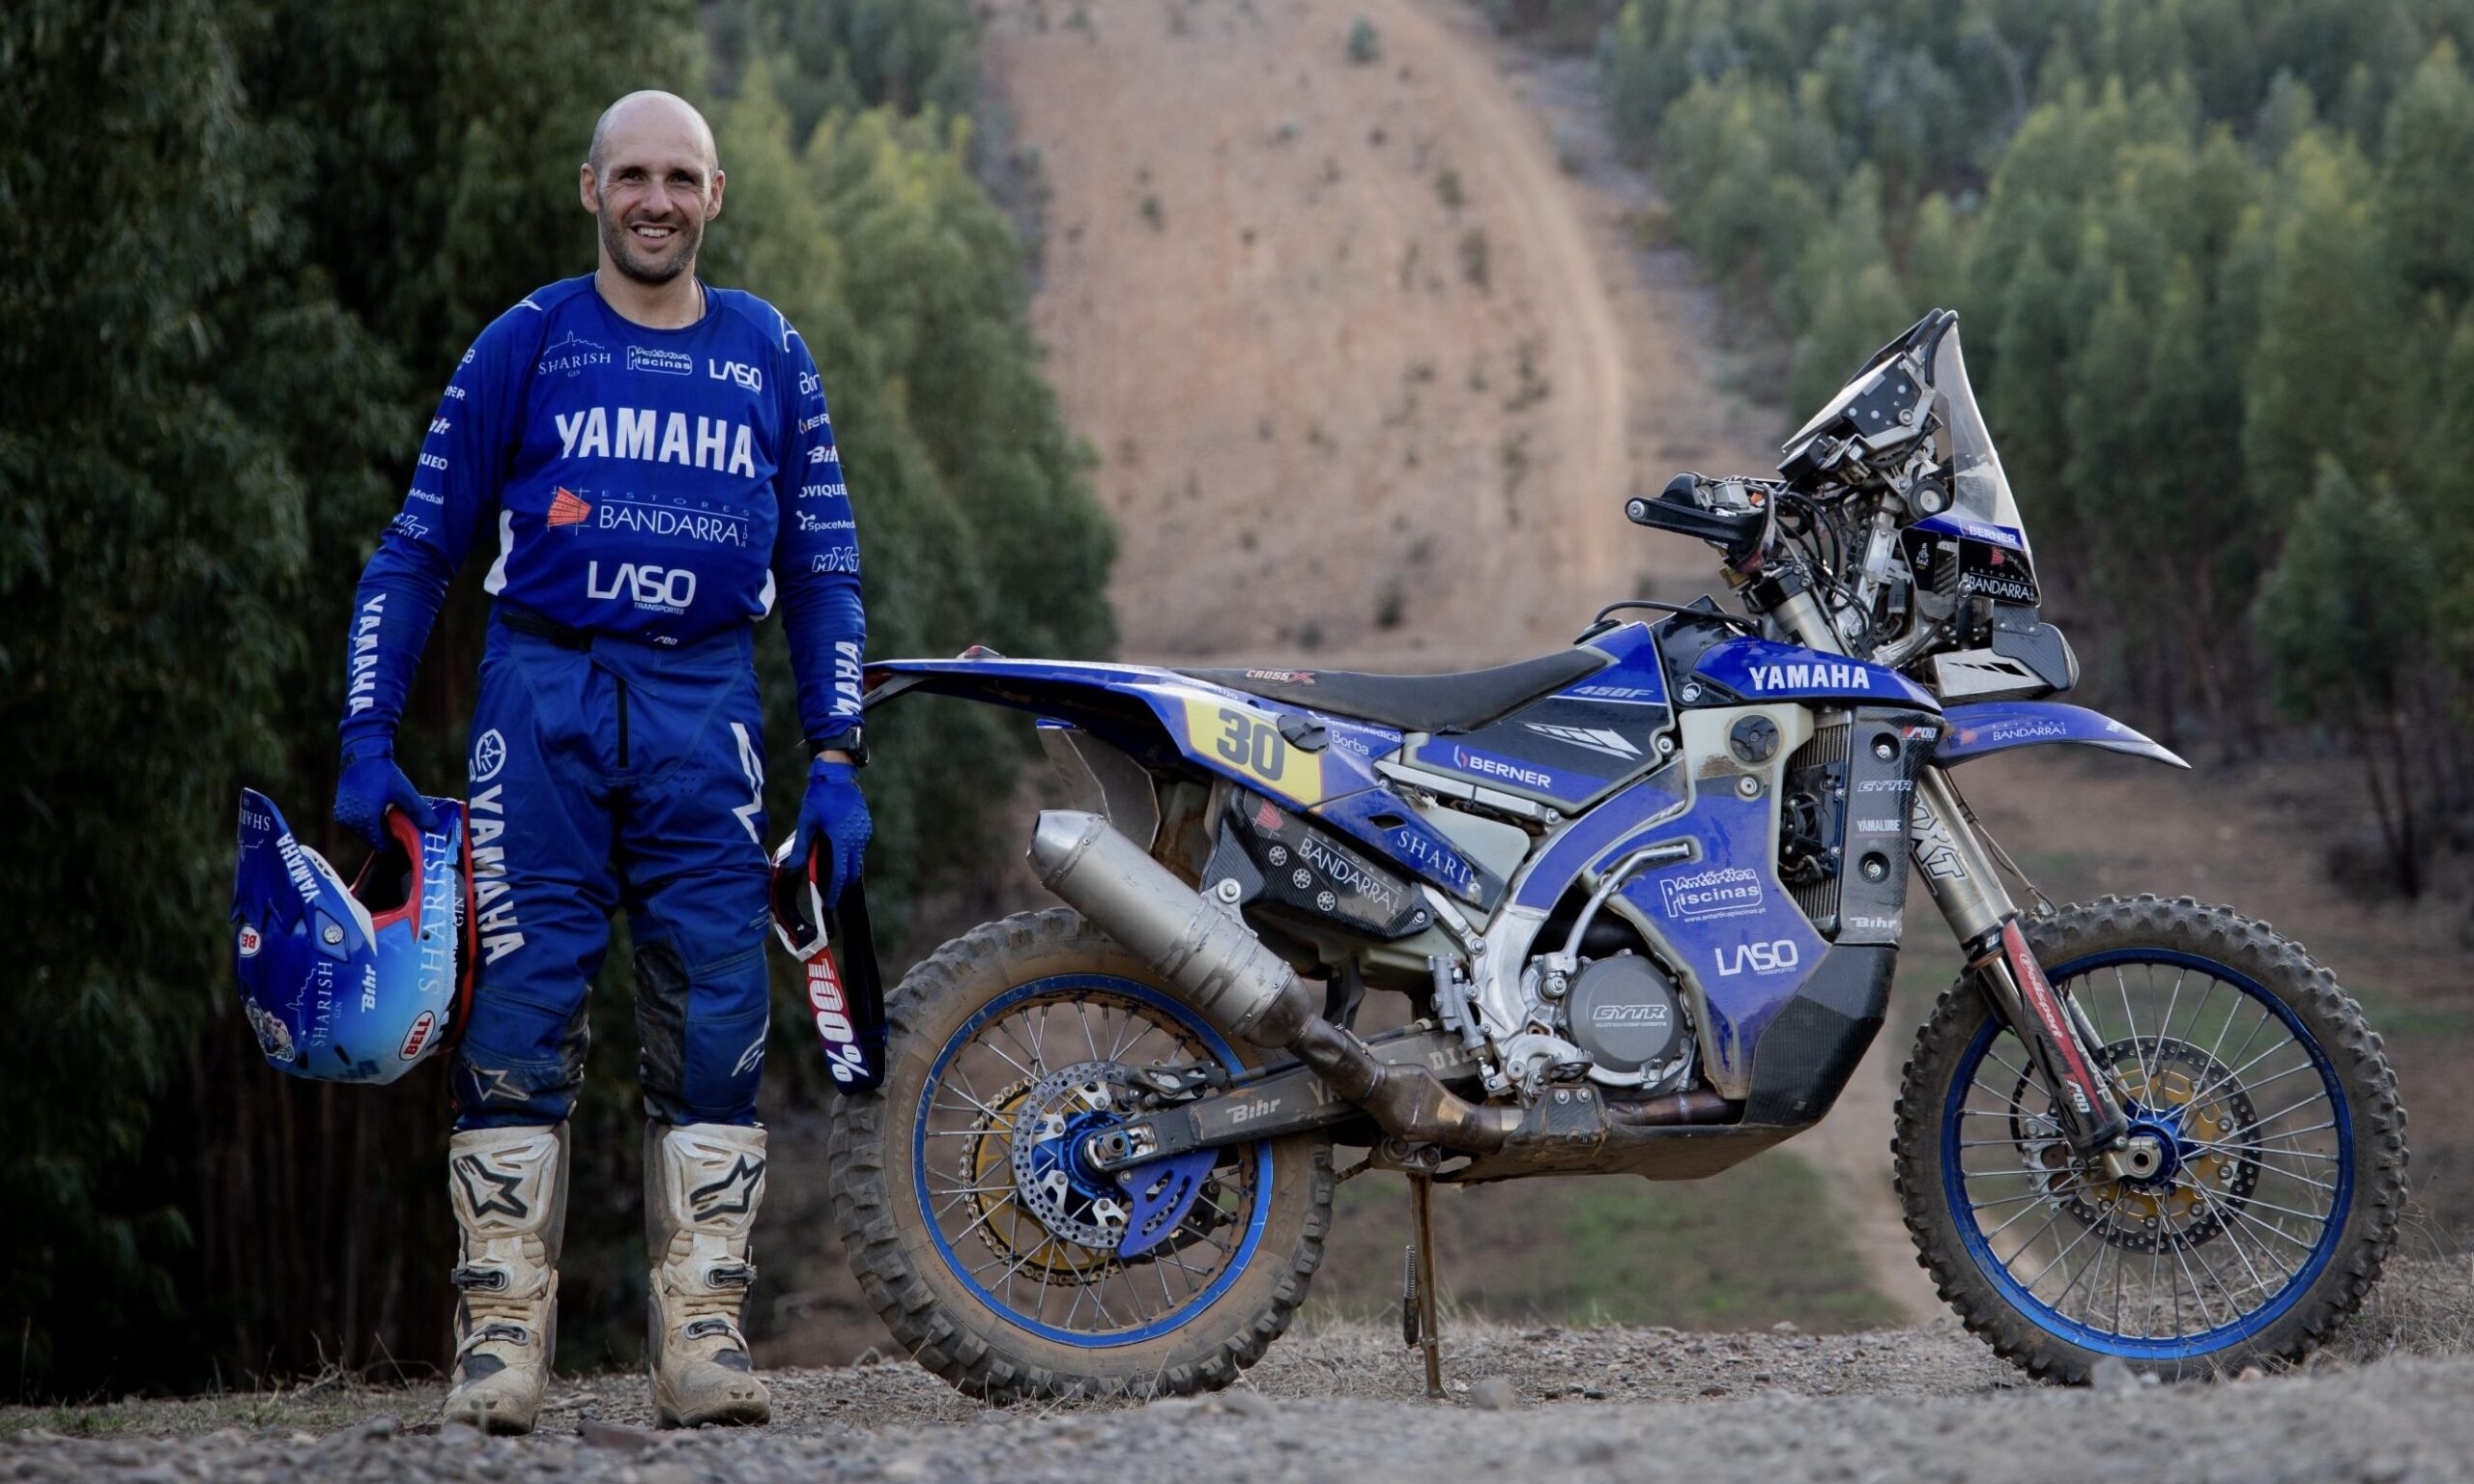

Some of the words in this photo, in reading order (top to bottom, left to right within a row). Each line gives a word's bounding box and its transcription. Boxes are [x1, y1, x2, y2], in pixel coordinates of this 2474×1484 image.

[538, 353, 612, 375] SHARISH
[708, 358, 762, 391] LASO
[555, 407, 757, 478] YAMAHA
[417, 452, 448, 471] UEO
[602, 490, 750, 516] ESTORES
[599, 505, 739, 547] BANDARRA
[1969, 526, 2017, 545] BERNER
[588, 560, 697, 608] LASO
[1969, 576, 2030, 600] BANDARRA
[349, 593, 387, 718] YAMAHA
[1572, 685, 1655, 699] 450F
[1748, 664, 1871, 691] YAMAHA
[1216, 706, 1285, 782] 30
[1331, 729, 1369, 756] Borba
[1993, 726, 2060, 742] BANDARRA
[1469, 756, 1552, 788] BERNER
[1857, 779, 1913, 792] GYTR
[276, 832, 322, 903] YAMAHA
[470, 784, 525, 965] YAMAHA
[1298, 837, 1391, 912] BANDARRA
[419, 832, 447, 993] SHARISH
[454, 897, 465, 927] GIN
[1660, 878, 1760, 919] Piscinas
[1850, 916, 1898, 928] Bihr
[1714, 939, 1798, 977] LASO
[310, 961, 333, 1047] SHARISH
[361, 963, 377, 1013] Bihr
[808, 957, 870, 1082] 100%
[1593, 1004, 1669, 1020] GYTR
[403, 1016, 432, 1056] BELL
[1225, 1096, 1281, 1125] Bihr
